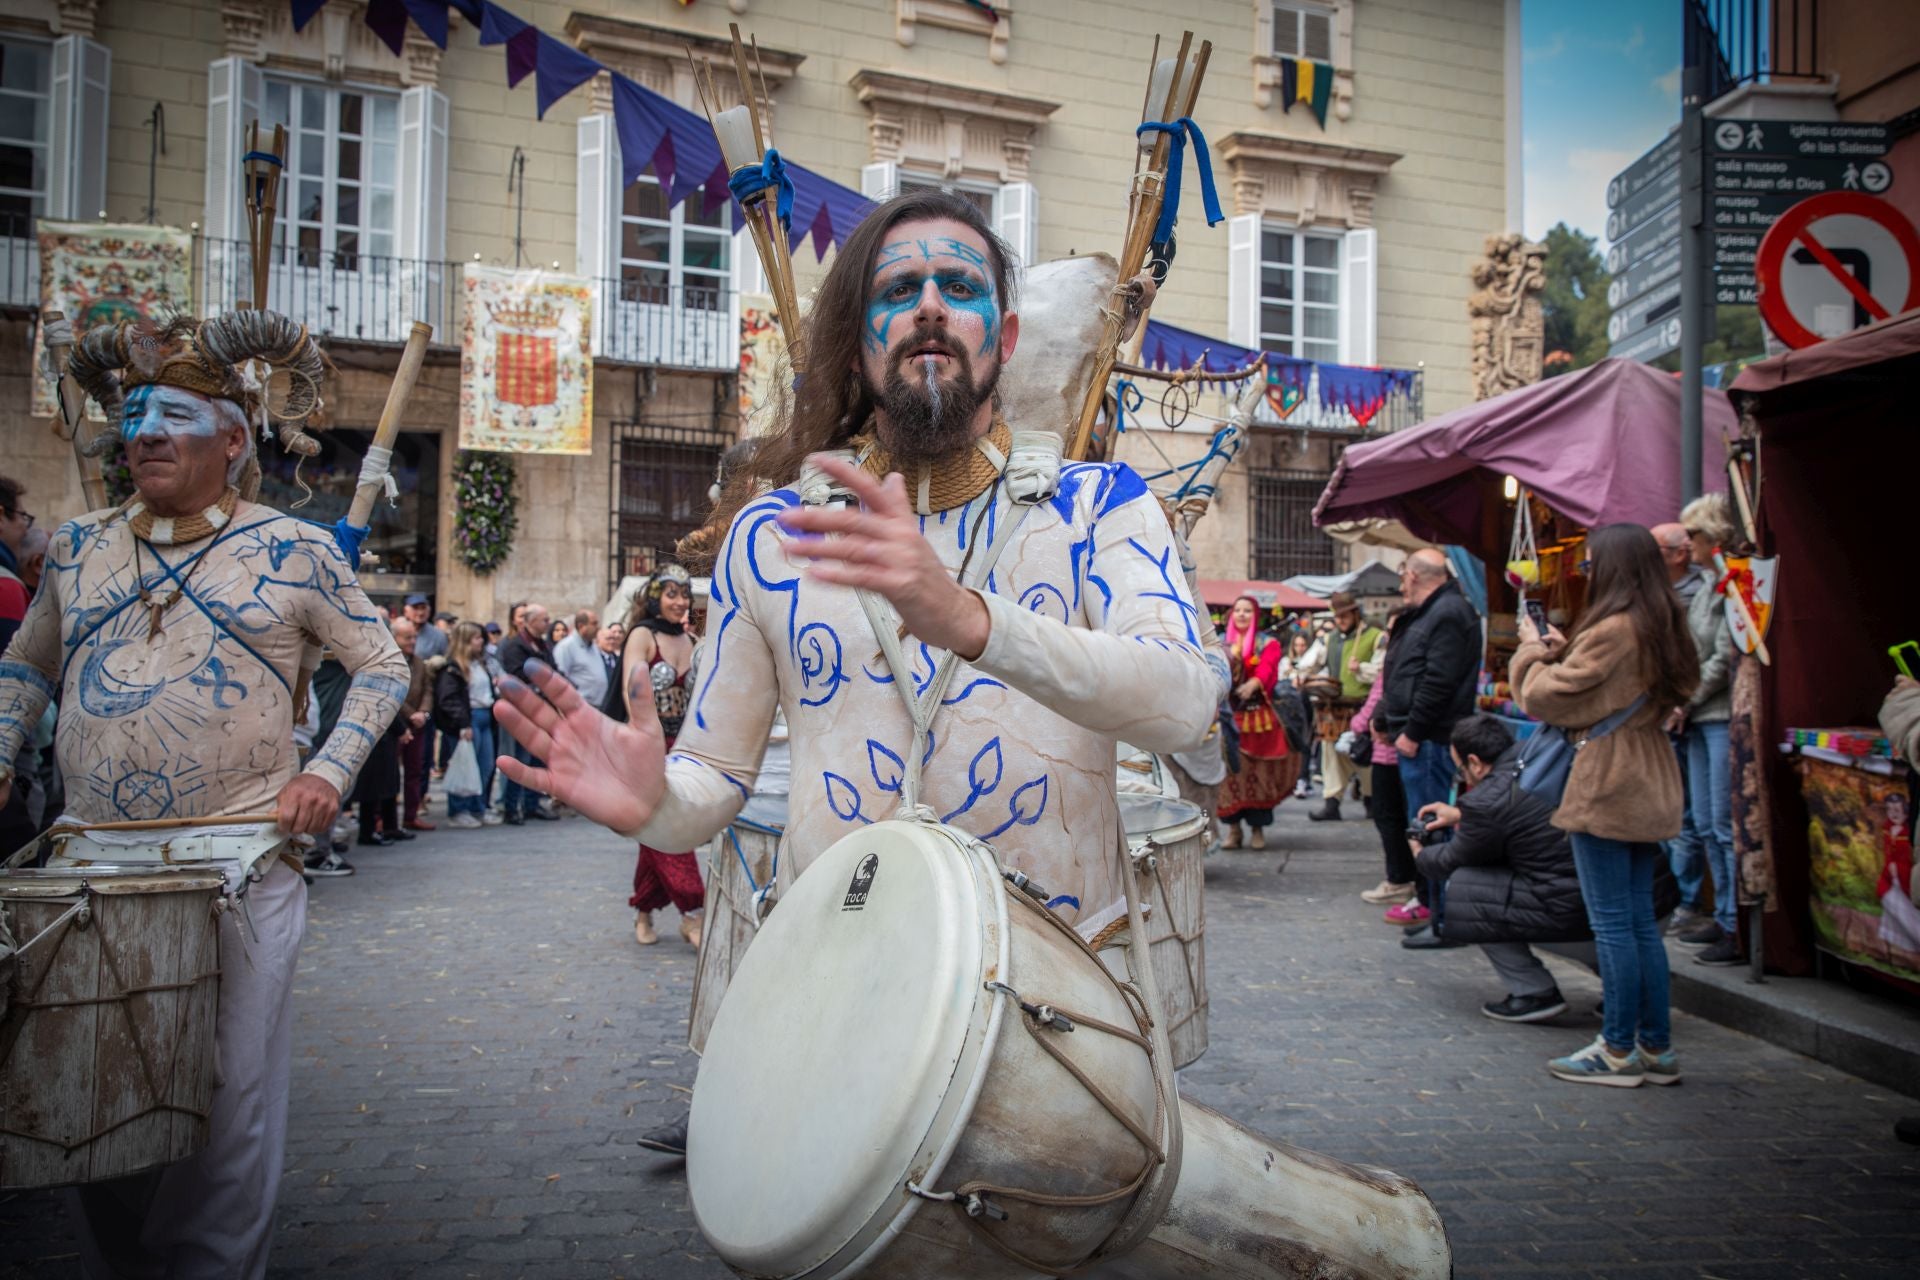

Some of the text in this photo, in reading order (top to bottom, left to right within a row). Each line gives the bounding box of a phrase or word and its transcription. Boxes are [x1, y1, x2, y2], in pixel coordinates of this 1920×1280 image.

[1789, 124, 1886, 138] iglesia convento
[1799, 140, 1886, 154] de las Salesas
[1715, 159, 1788, 173] sala museo
[1714, 175, 1826, 190] San Juan de Dios
[1715, 196, 1760, 207] museo
[1715, 211, 1733, 224] de
[1734, 211, 1747, 224] la
[1715, 234, 1757, 248] iglesia
[1717, 288, 1736, 302] de
[846, 892, 867, 903] TOCA
